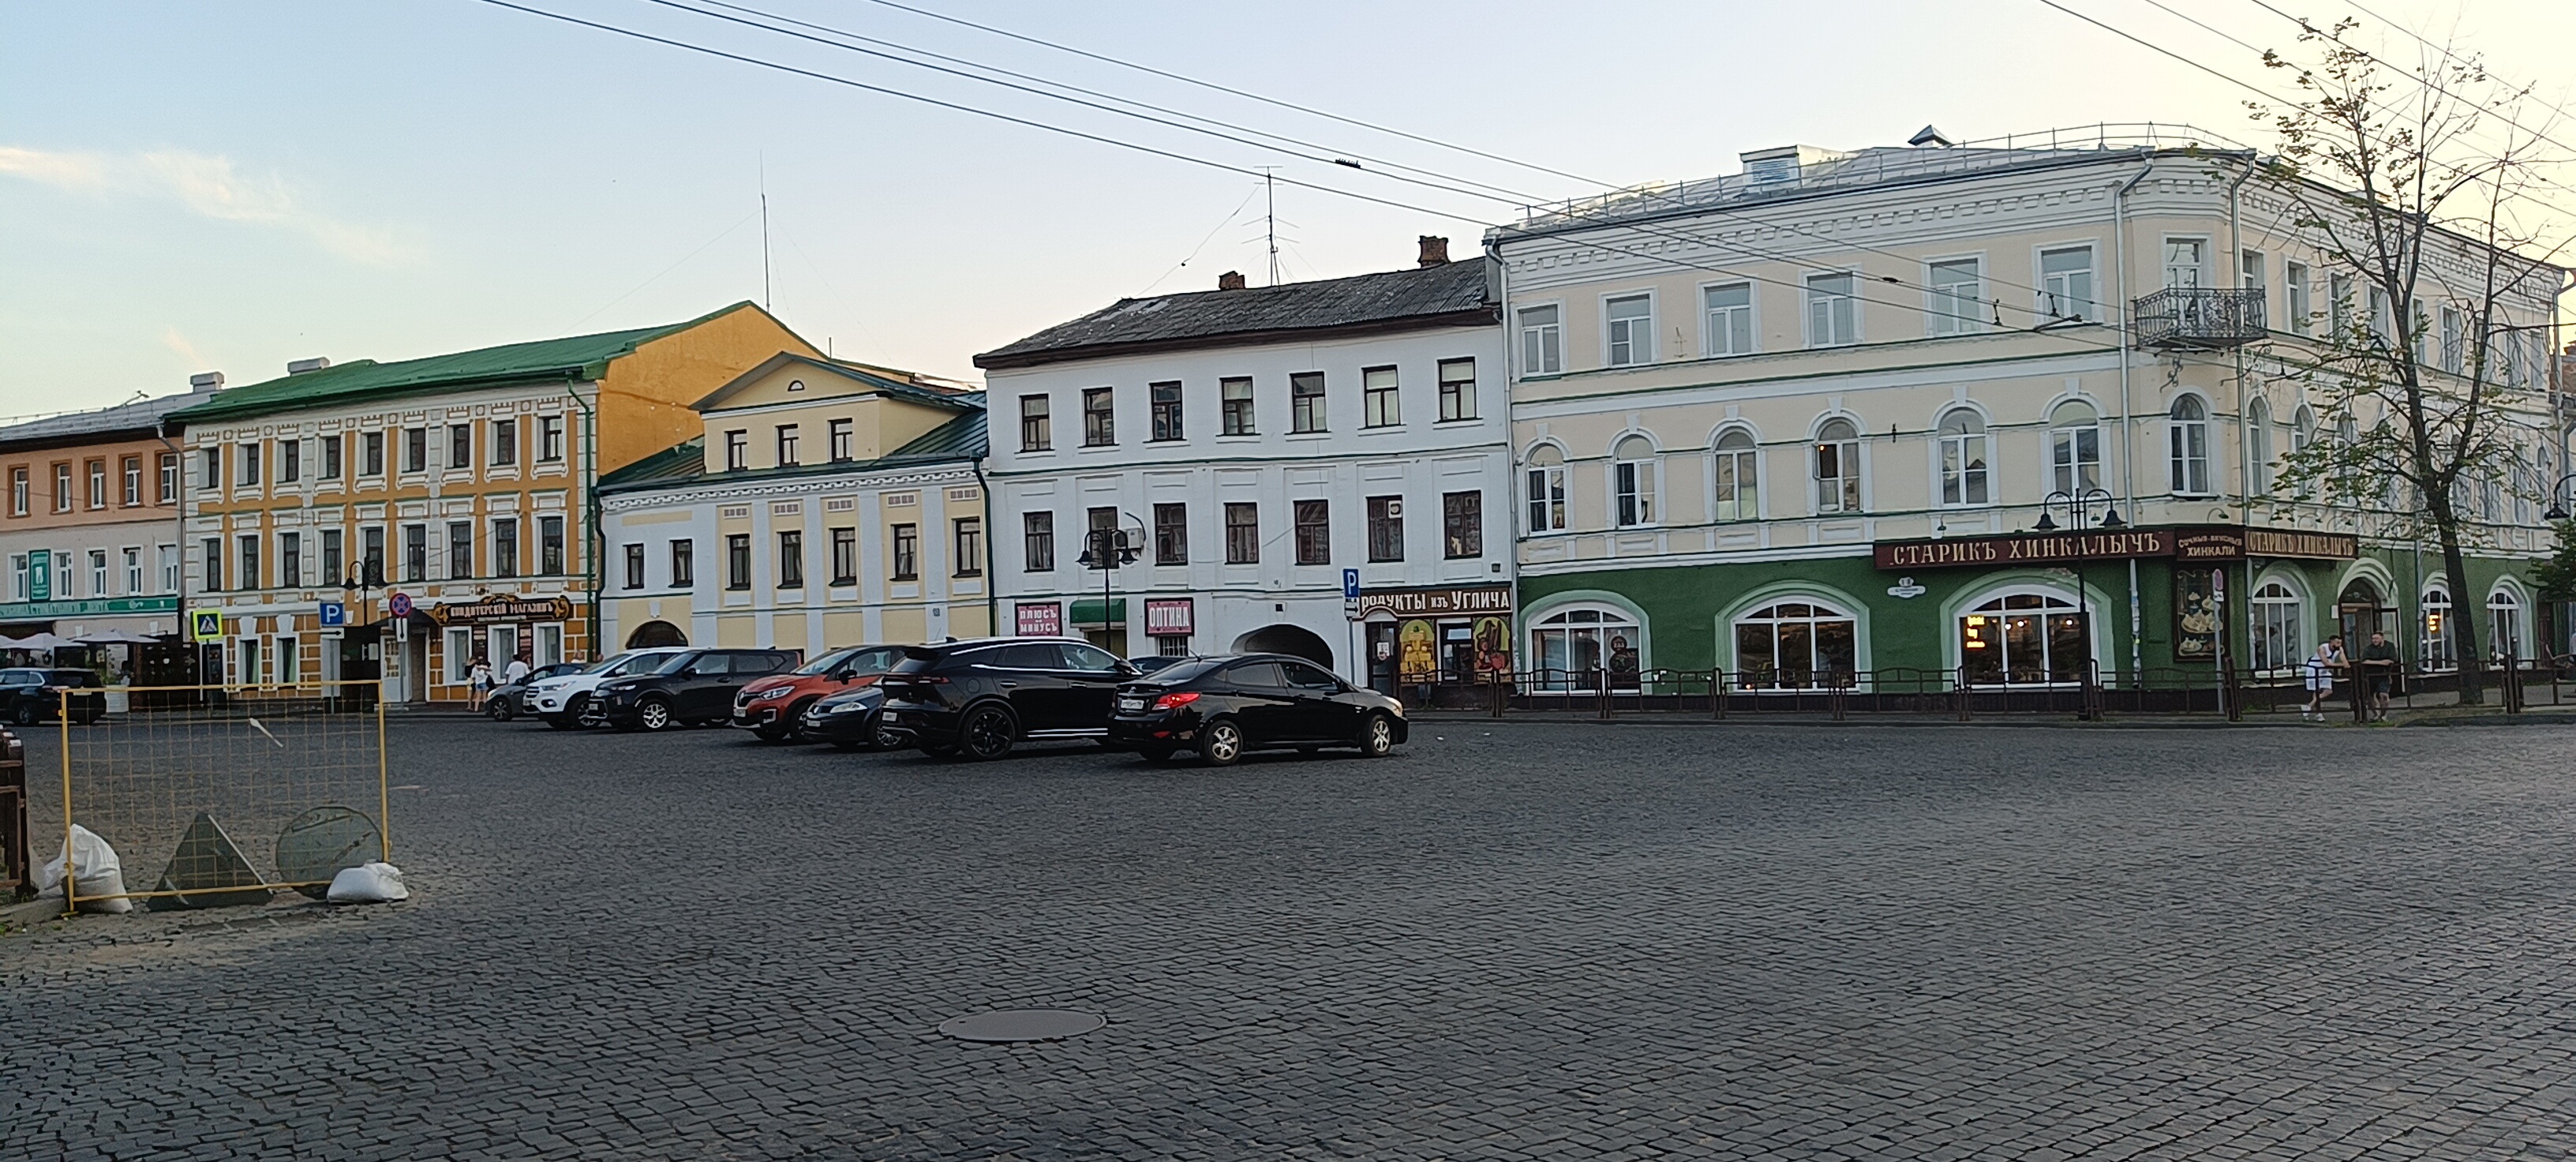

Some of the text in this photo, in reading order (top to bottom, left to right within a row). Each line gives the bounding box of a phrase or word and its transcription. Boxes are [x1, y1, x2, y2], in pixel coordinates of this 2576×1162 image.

[1894, 533, 2161, 565] СТАРИКЪ ХИНКАЛЫЧЪ
[2187, 546, 2236, 557] ХИНКАЛИ
[1353, 594, 1426, 612] РОДУКТЫ
[1020, 609, 1058, 620] ПЛЮСЪ
[1020, 622, 1058, 633] МИНУСЪ
